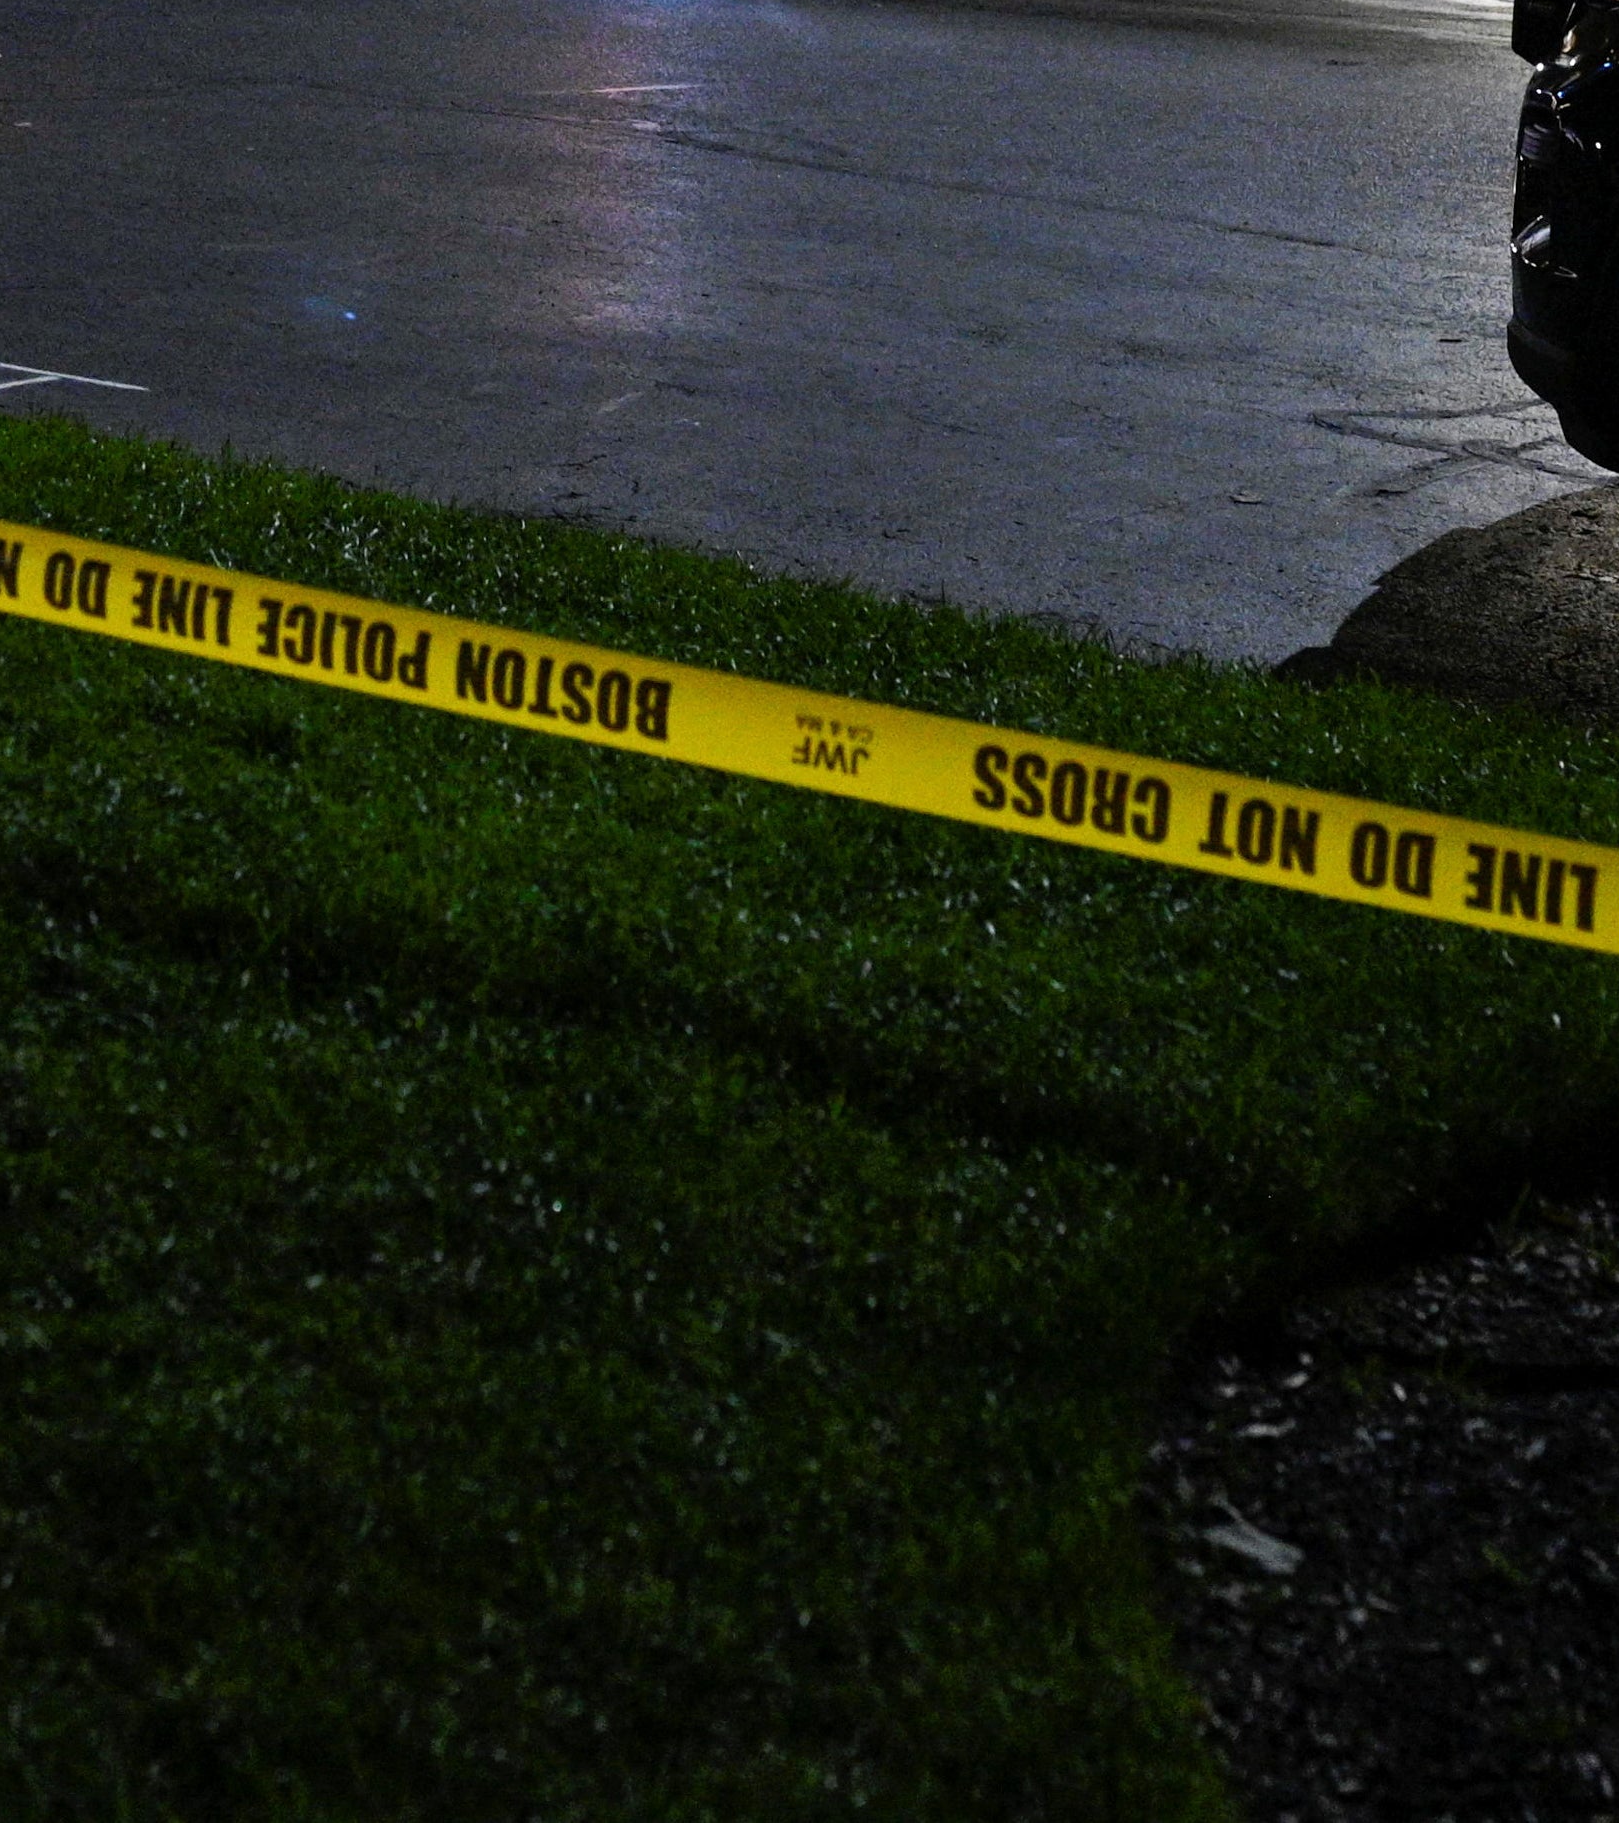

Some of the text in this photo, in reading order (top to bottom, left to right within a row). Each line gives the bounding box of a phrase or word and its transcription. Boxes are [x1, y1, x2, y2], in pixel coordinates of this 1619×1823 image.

[41, 550, 113, 620] DO
[131, 569, 235, 648] LINE
[256, 598, 432, 691] POLICE
[454, 638, 673, 743] BOSTON
[791, 735, 871, 778] JWF
[972, 744, 1173, 845] CROSS
[1198, 790, 1321, 877] NOT
[1349, 821, 1438, 900] DO
[1465, 843, 1598, 933] LINE
